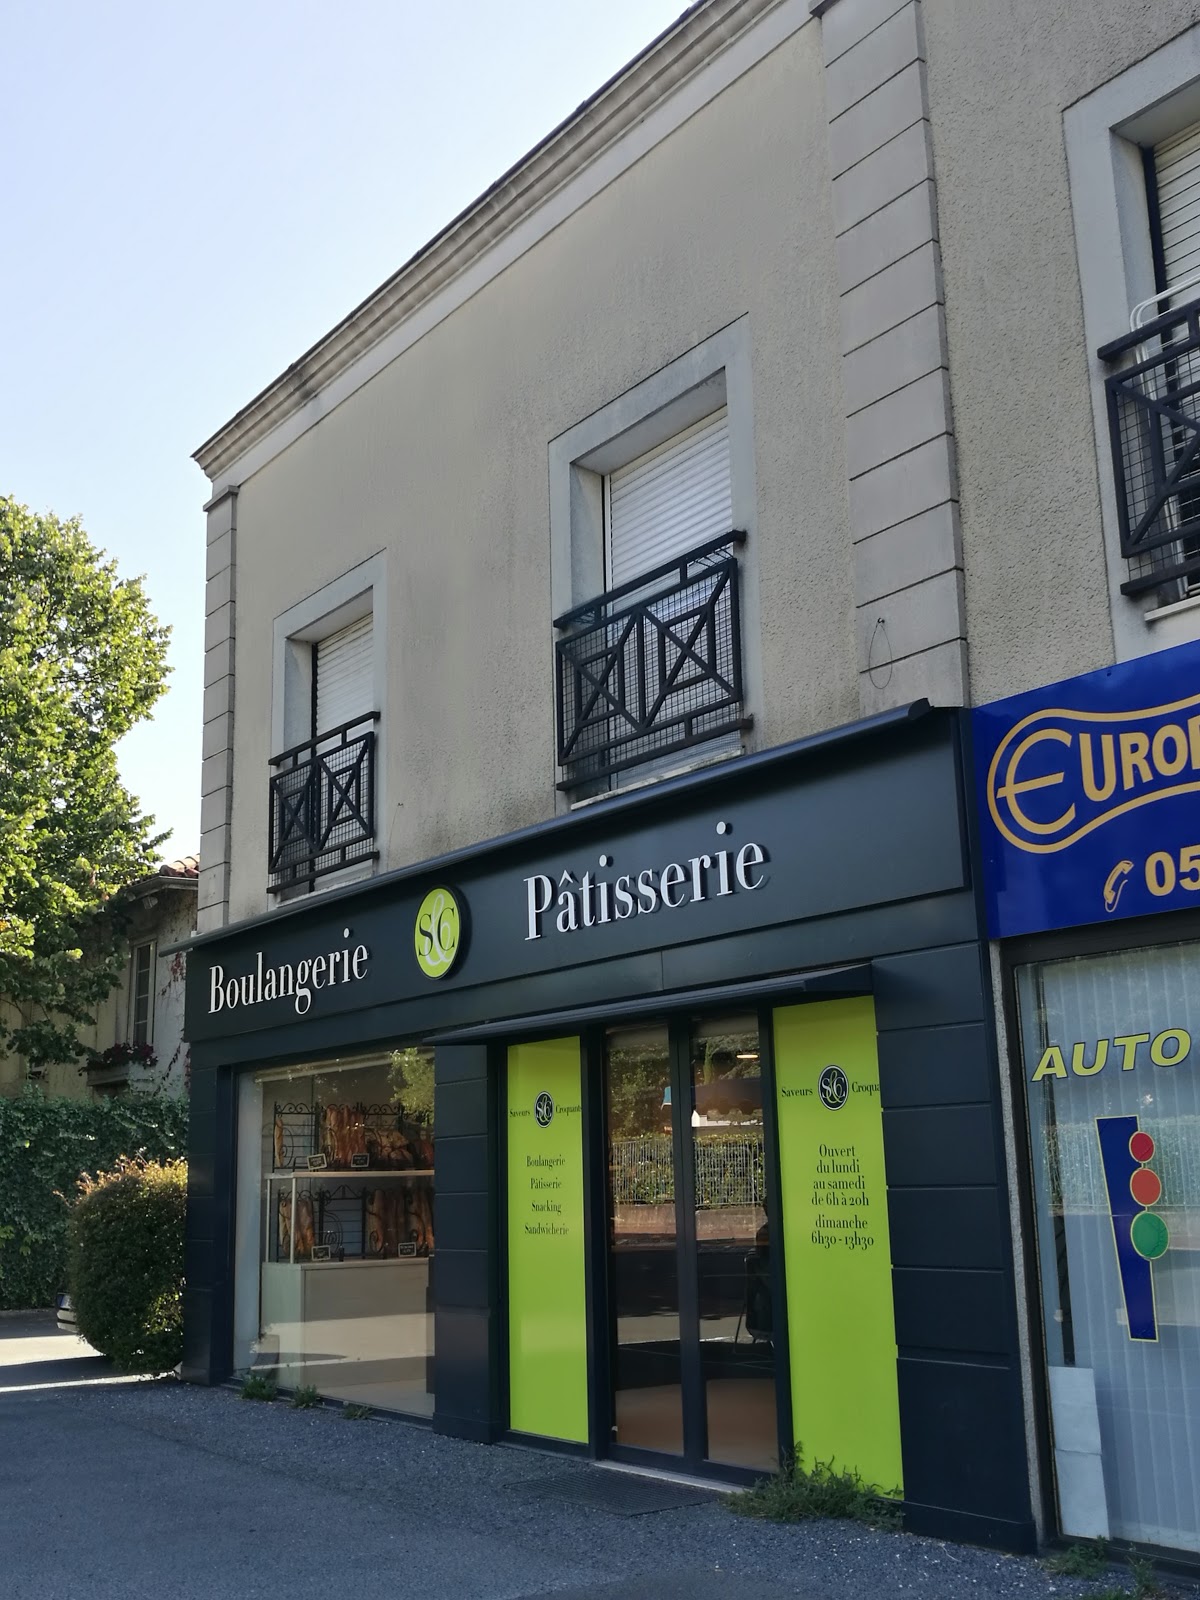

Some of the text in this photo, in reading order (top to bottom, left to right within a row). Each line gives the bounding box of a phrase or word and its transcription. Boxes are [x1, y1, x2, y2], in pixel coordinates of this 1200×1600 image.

[1144, 844, 1200, 896] 05
[523, 820, 765, 941] Pâtisserie
[207, 927, 368, 1014] Boulangerie
[1030, 1027, 1192, 1083] AUTO
[781, 1087, 813, 1097] Saveurs
[509, 1109, 531, 1118] Saveurs
[819, 1144, 855, 1157] Ouvert
[526, 1154, 566, 1170] Boulangerie
[816, 1158, 860, 1173] du lundi
[813, 1175, 866, 1190] au samedi
[811, 1191, 869, 1206] de 6h à 20h
[531, 1199, 562, 1216] Snacking
[524, 1222, 570, 1235] Sandwicherie
[815, 1214, 868, 1229] dimanche
[811, 1230, 837, 1249] 6h30
[844, 1231, 874, 1250] 13h30
